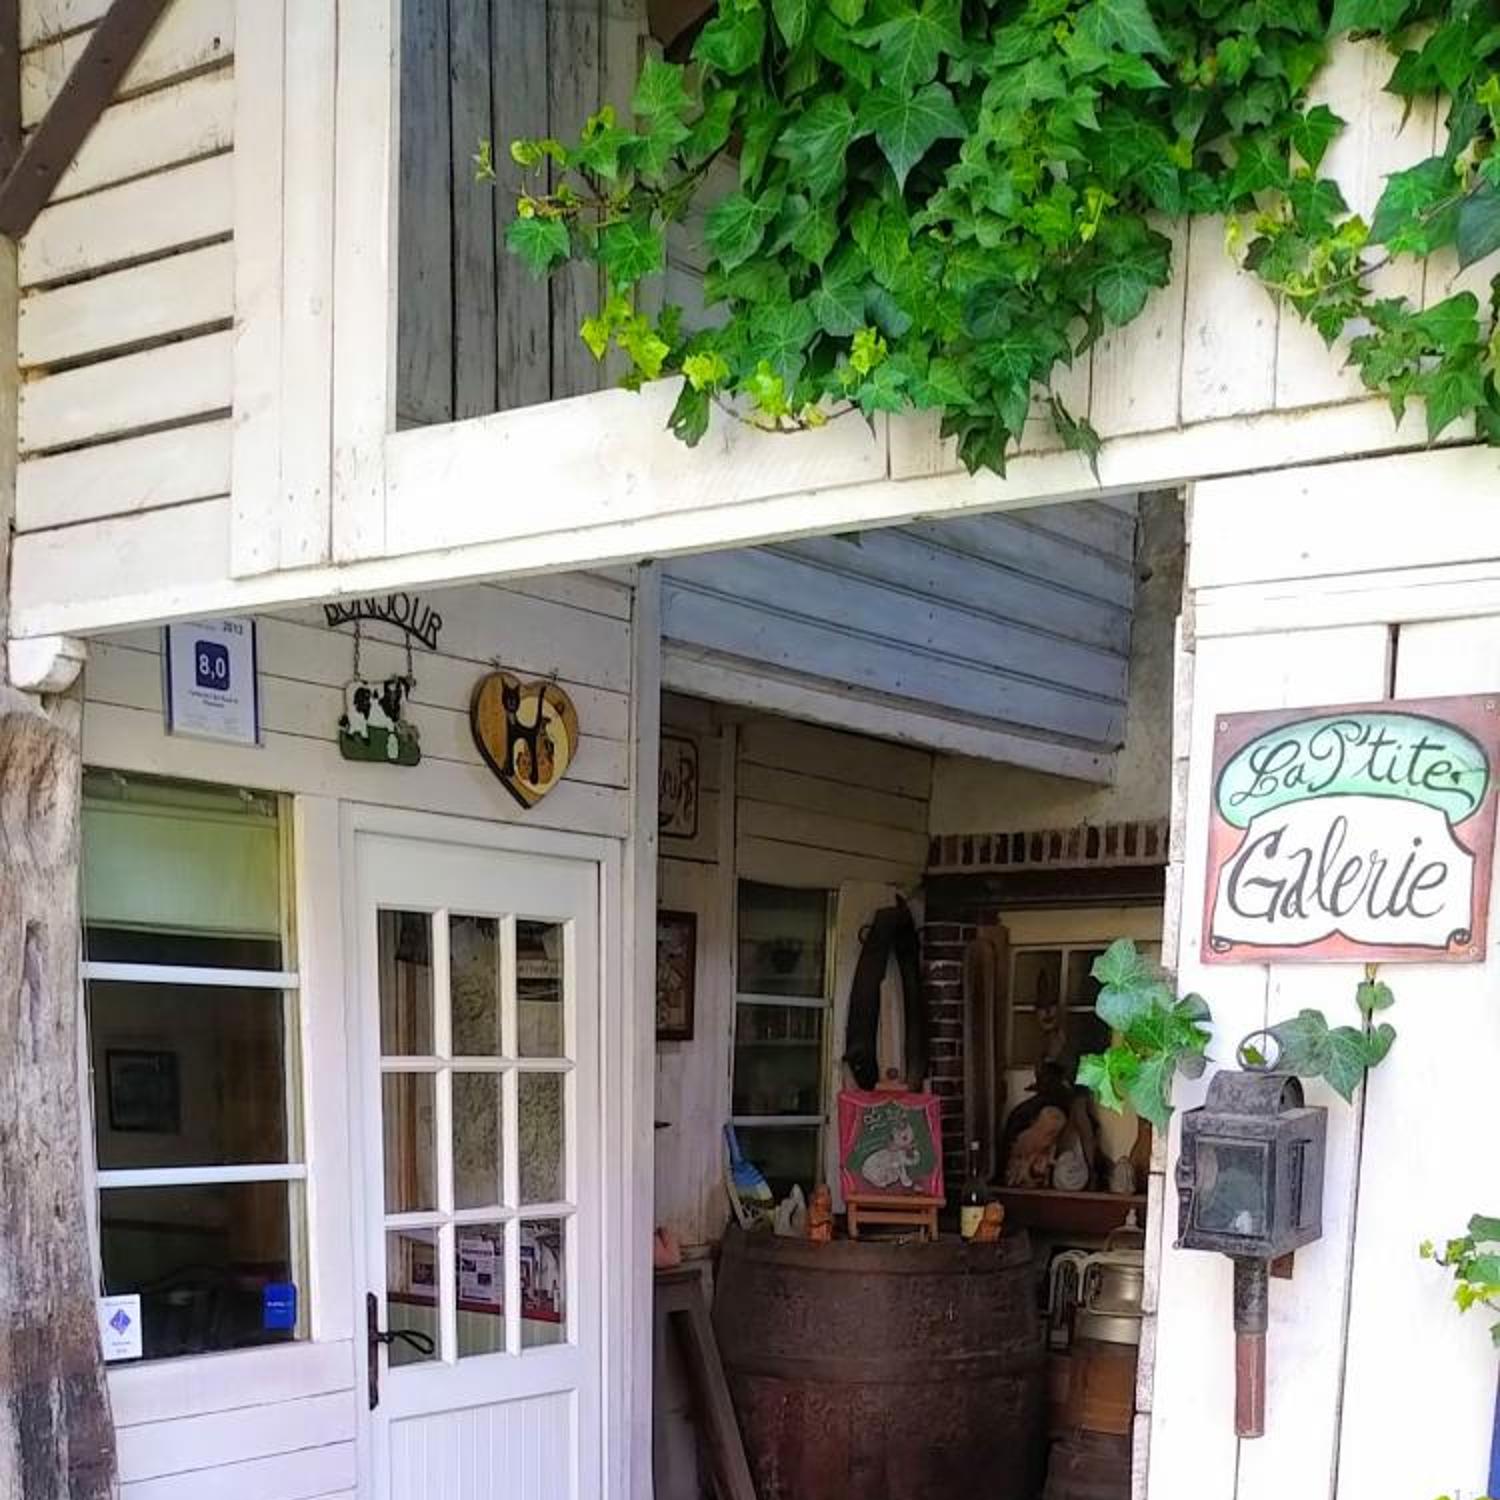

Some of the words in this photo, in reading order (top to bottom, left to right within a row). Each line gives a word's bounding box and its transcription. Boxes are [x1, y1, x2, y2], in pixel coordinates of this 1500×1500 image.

[199, 653, 226, 681] 8,0
[1230, 739, 1307, 805] La
[1226, 815, 1449, 923] Galerie
